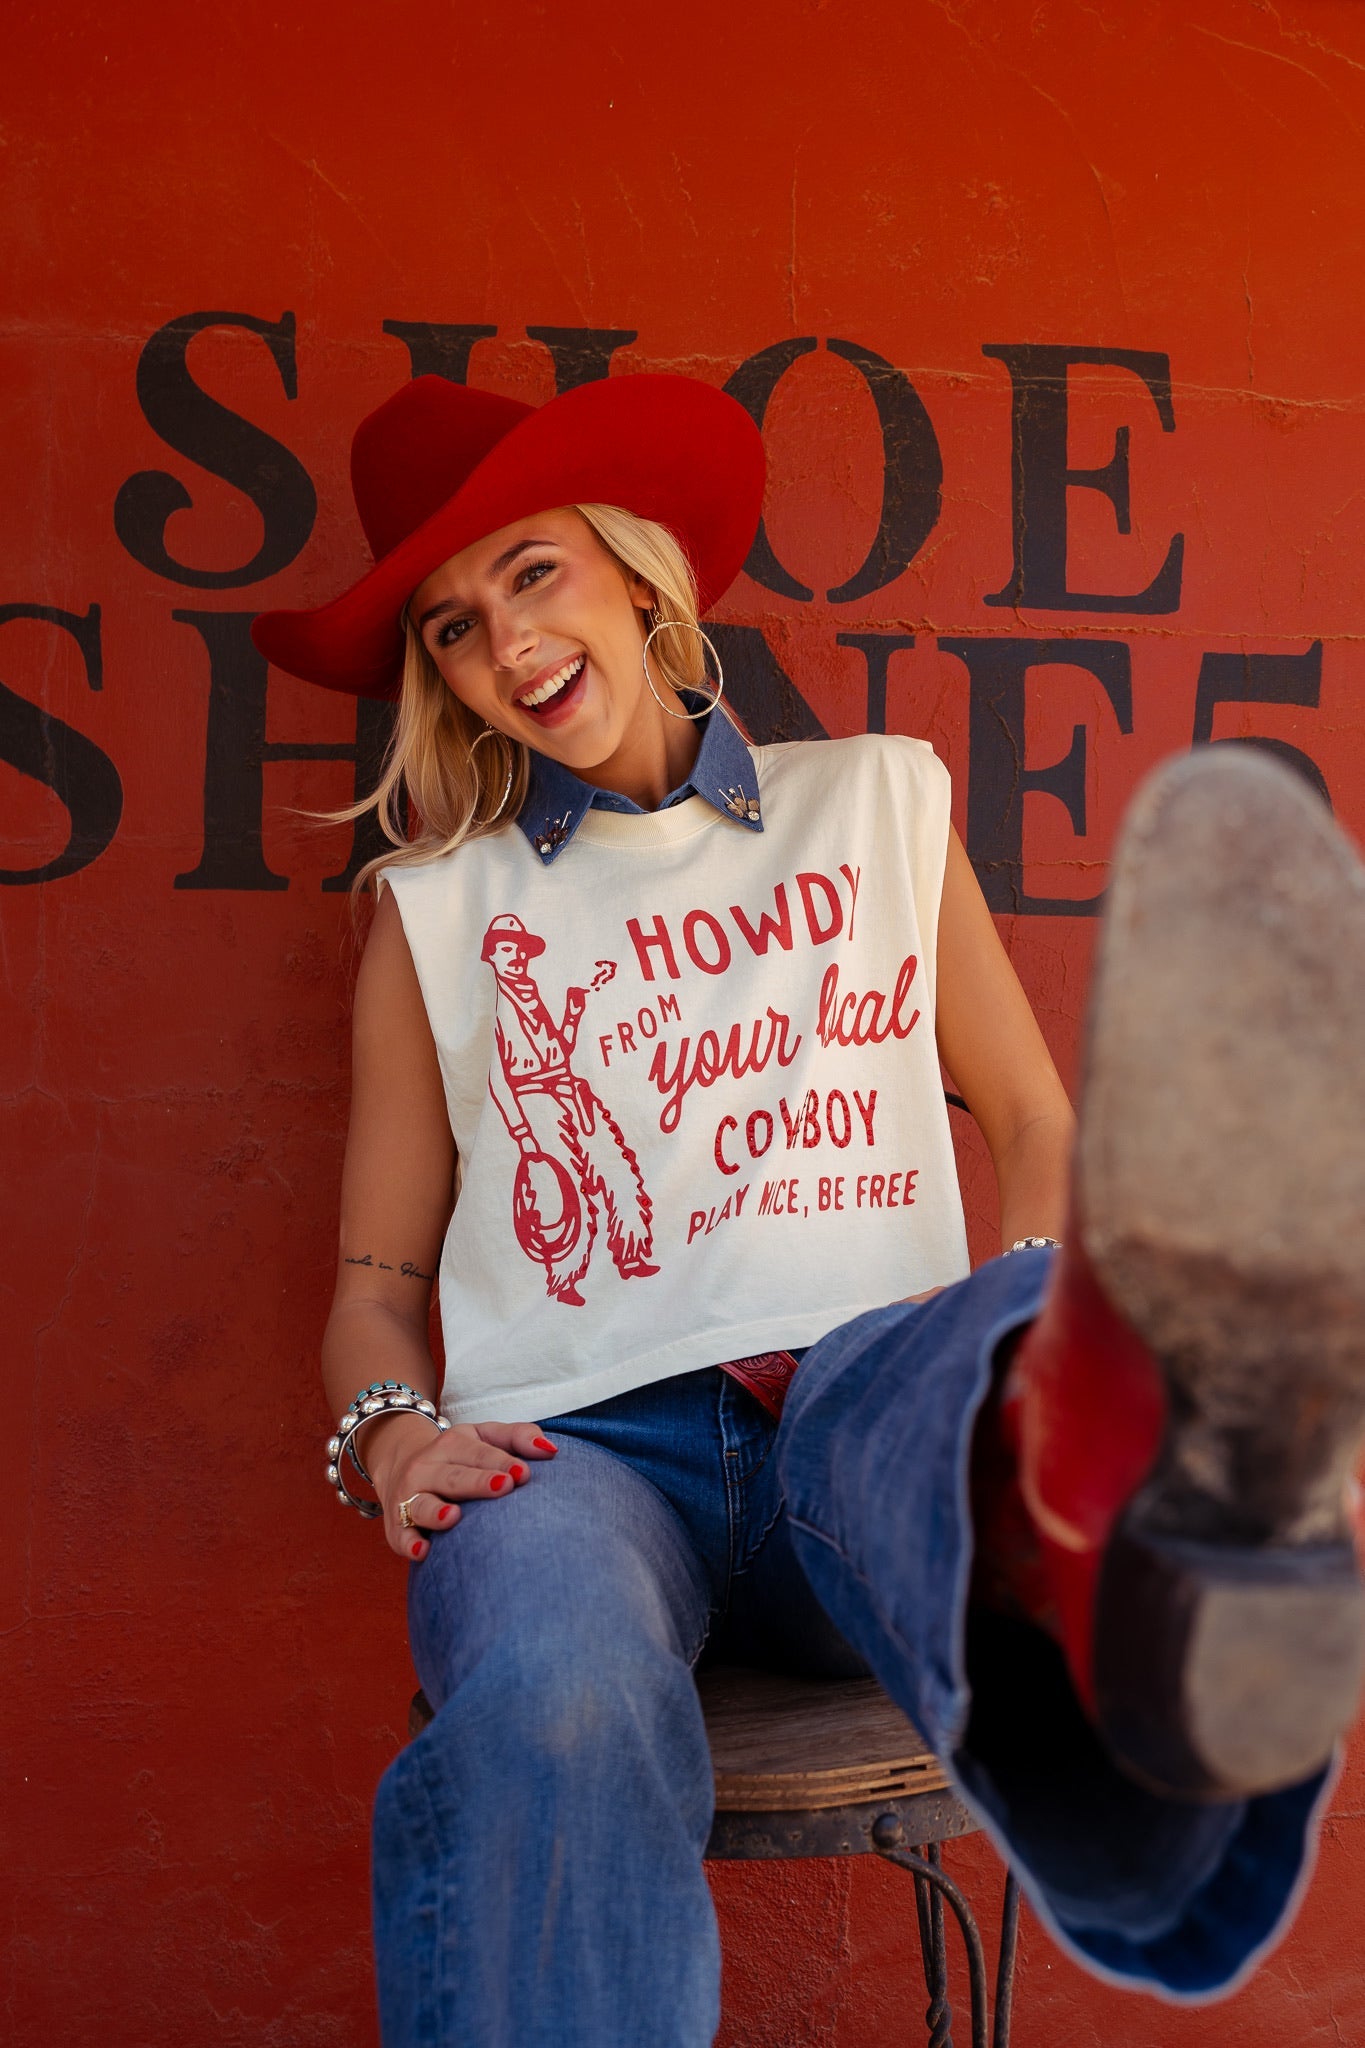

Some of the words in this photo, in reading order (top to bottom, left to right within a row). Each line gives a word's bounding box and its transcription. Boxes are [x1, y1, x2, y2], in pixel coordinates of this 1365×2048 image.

[625, 863, 861, 982] HOWDY
[599, 993, 682, 1067] FROM
[648, 1005, 803, 1135] your
[713, 1088, 878, 1176] COWBOY
[686, 1183, 750, 1245] PLAY
[757, 1178, 809, 1218] NICE,
[818, 1176, 845, 1212] BE
[856, 1169, 919, 1209] FREE
